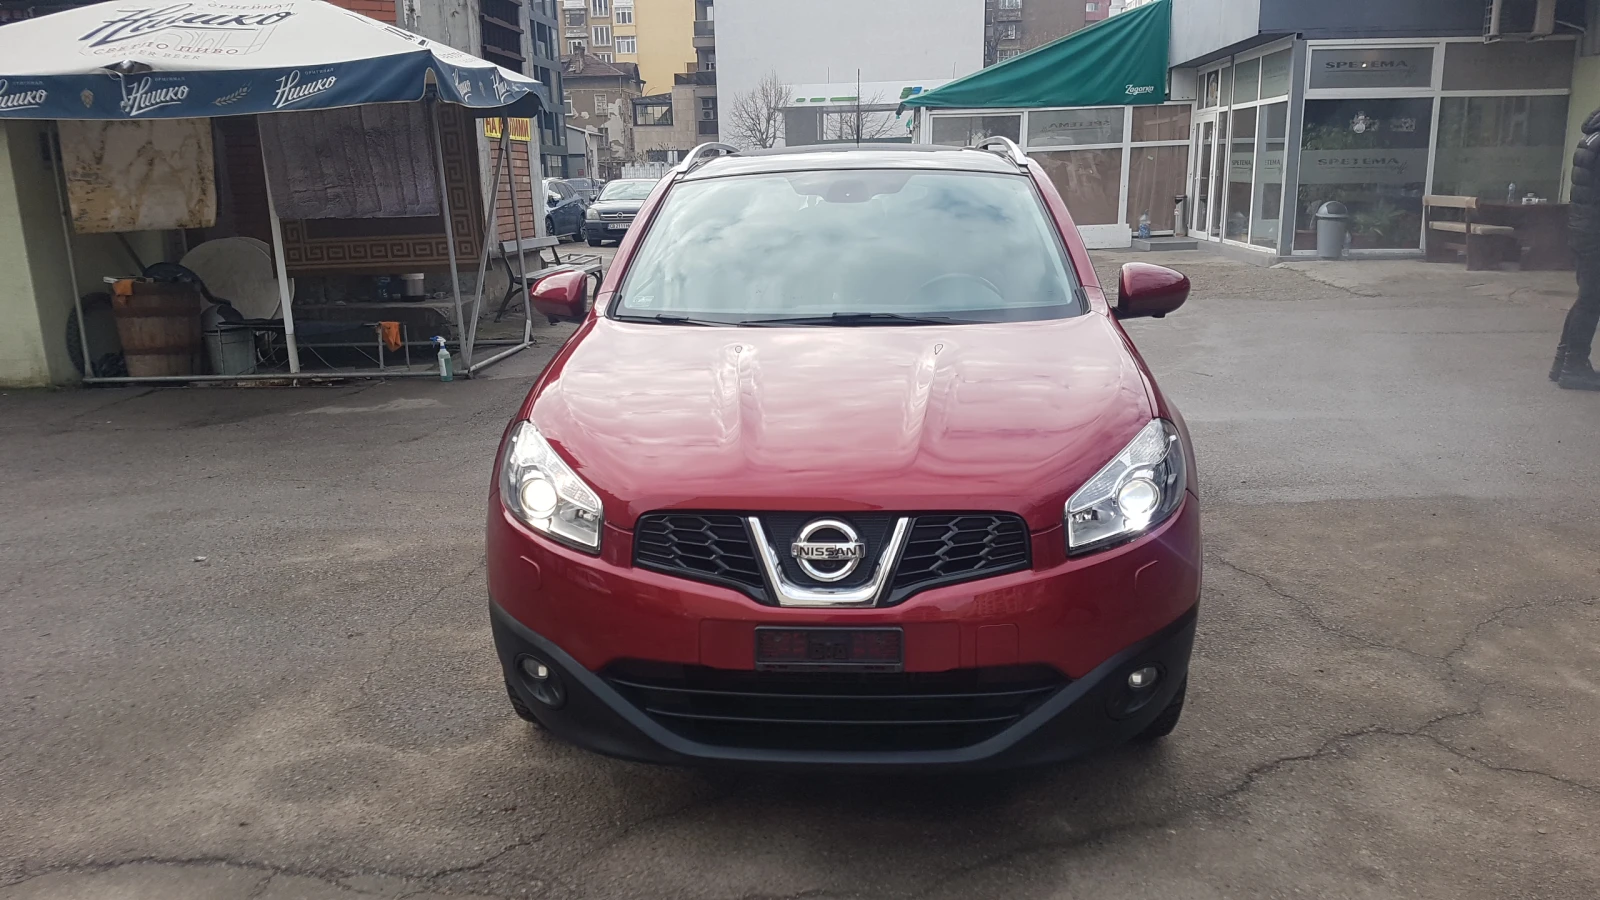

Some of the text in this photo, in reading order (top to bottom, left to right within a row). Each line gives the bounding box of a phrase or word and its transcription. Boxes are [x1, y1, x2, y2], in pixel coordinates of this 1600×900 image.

[179, 45, 239, 55] ПИВО
[162, 52, 201, 60] BEER
[1325, 60, 1409, 69] SPEEMA
[272, 69, 338, 109] Нишко
[799, 546, 857, 557] NISSAN
